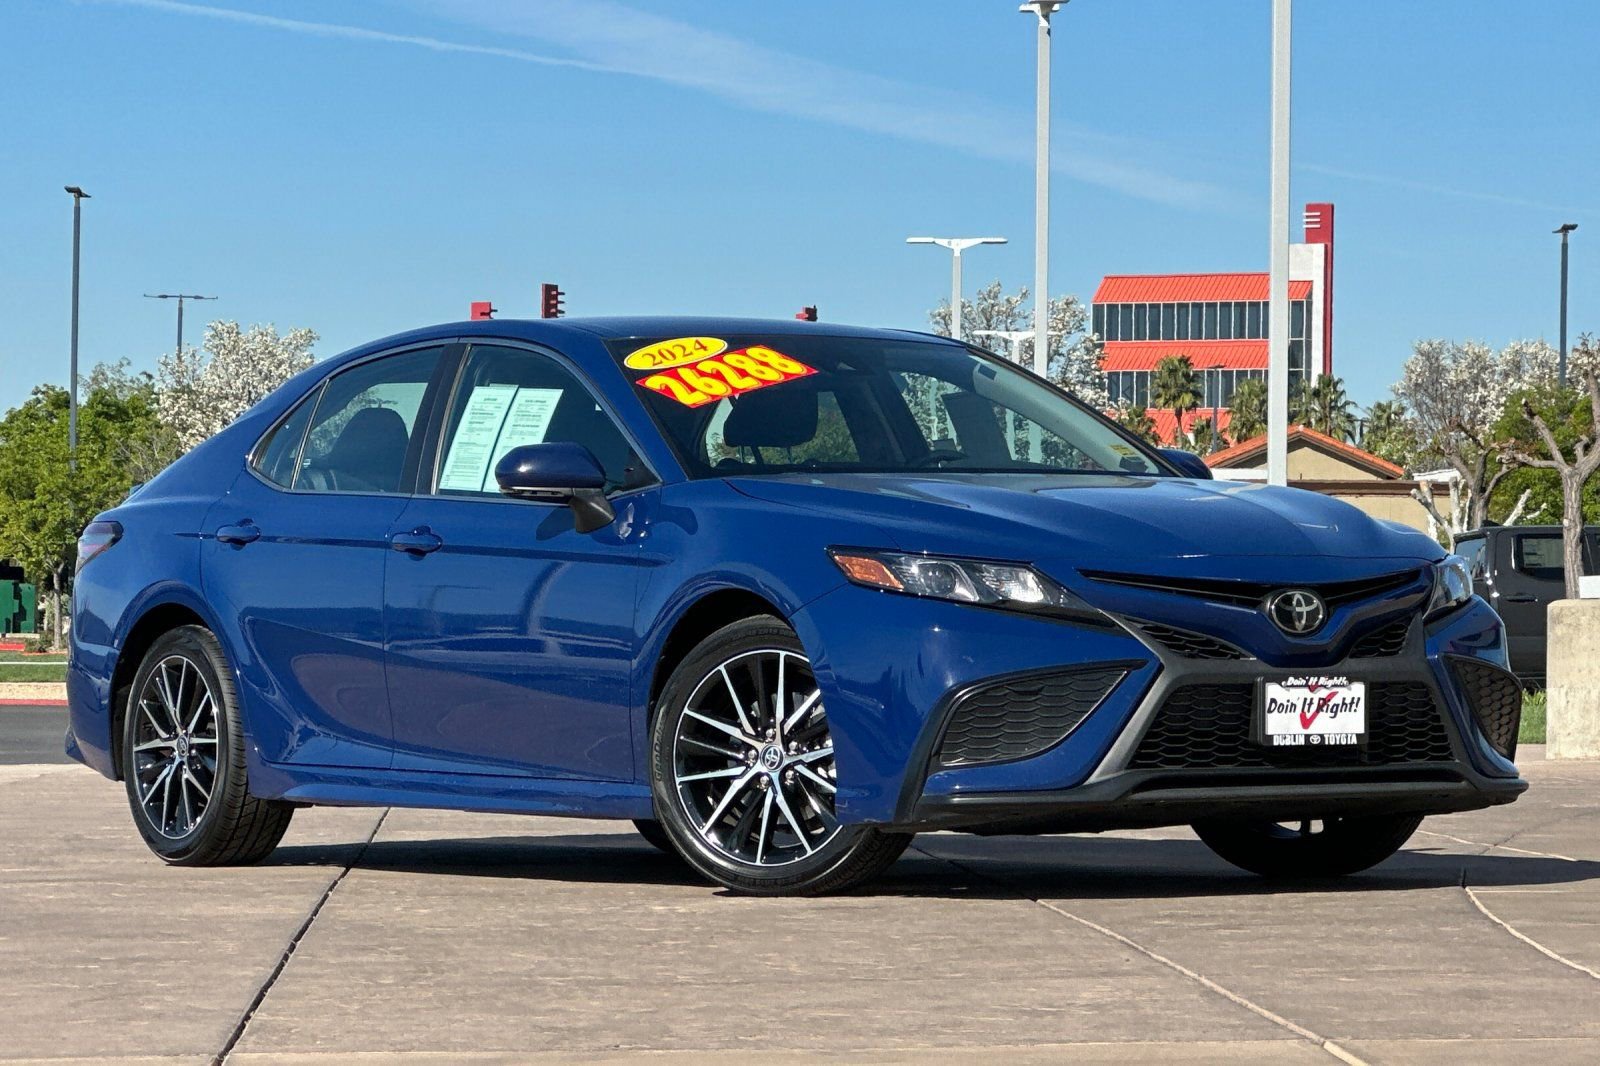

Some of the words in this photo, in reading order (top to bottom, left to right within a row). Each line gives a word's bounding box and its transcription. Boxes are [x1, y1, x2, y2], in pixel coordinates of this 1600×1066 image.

[642, 339, 708, 366] 2024
[645, 347, 807, 405] 26288
[1301, 697, 1314, 714] It
[1316, 697, 1360, 719] Right!
[1273, 734, 1305, 746] DUBLIN
[1323, 733, 1357, 745] TOYOTA
